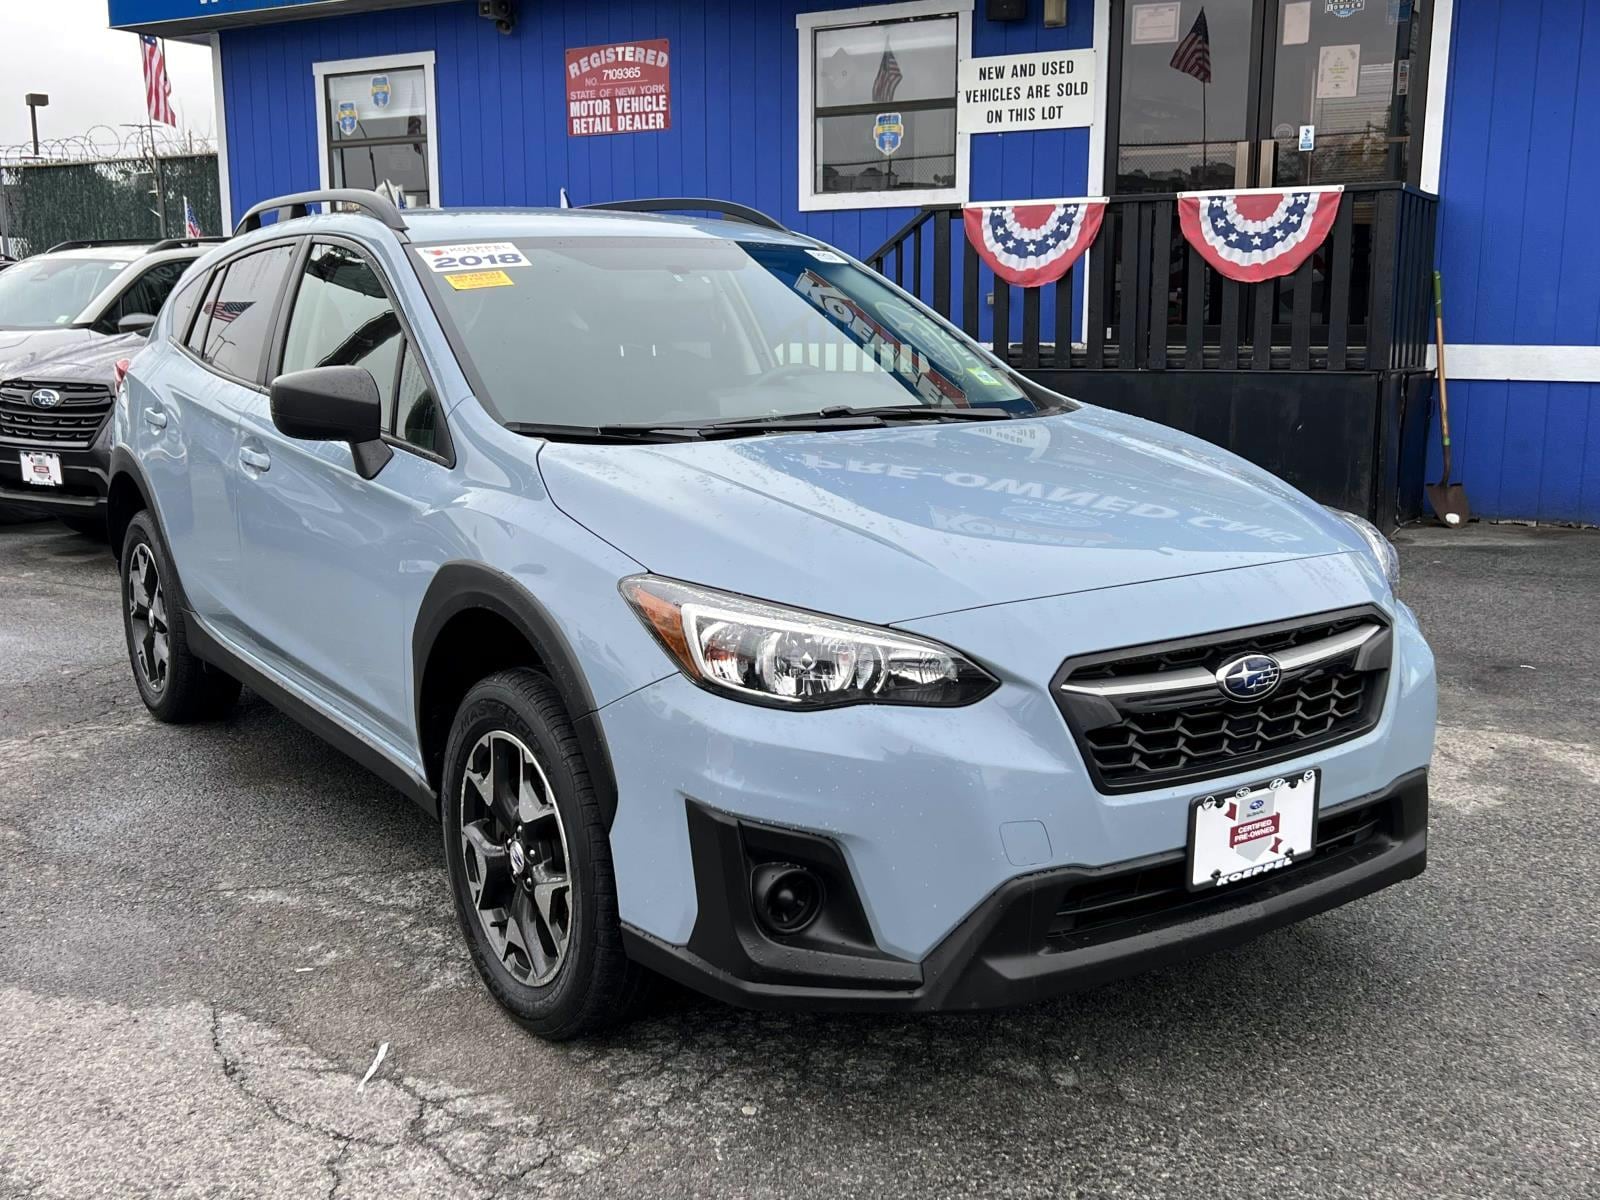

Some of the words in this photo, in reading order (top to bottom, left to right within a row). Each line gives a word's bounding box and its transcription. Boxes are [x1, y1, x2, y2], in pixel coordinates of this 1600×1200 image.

[568, 46, 669, 79] REGISTERED
[979, 65, 1005, 81] NEW
[1011, 63, 1036, 78] AND
[1042, 60, 1074, 76] USED
[602, 67, 641, 80] 7109365
[570, 89, 596, 100] STATE
[600, 88, 612, 98] OF
[615, 86, 636, 96] NEW
[640, 84, 666, 94] YORK
[965, 86, 1021, 103] VEHICLES
[1027, 84, 1050, 99] ARE
[1057, 81, 1088, 97] SOLD
[570, 98, 611, 117] MOTOR
[615, 94, 667, 113] VEHICLE
[987, 109, 1002, 124] ON
[1008, 107, 1035, 122] THIS
[1041, 105, 1064, 120] LOT
[572, 116, 613, 134] RETAIL
[617, 112, 665, 131] DEALER
[433, 253, 522, 268] 2018
[1234, 825, 1275, 842] PRE-OWNED
[1238, 819, 1272, 833] CERTIFIED
[1216, 857, 1293, 886] KOEPPEL
